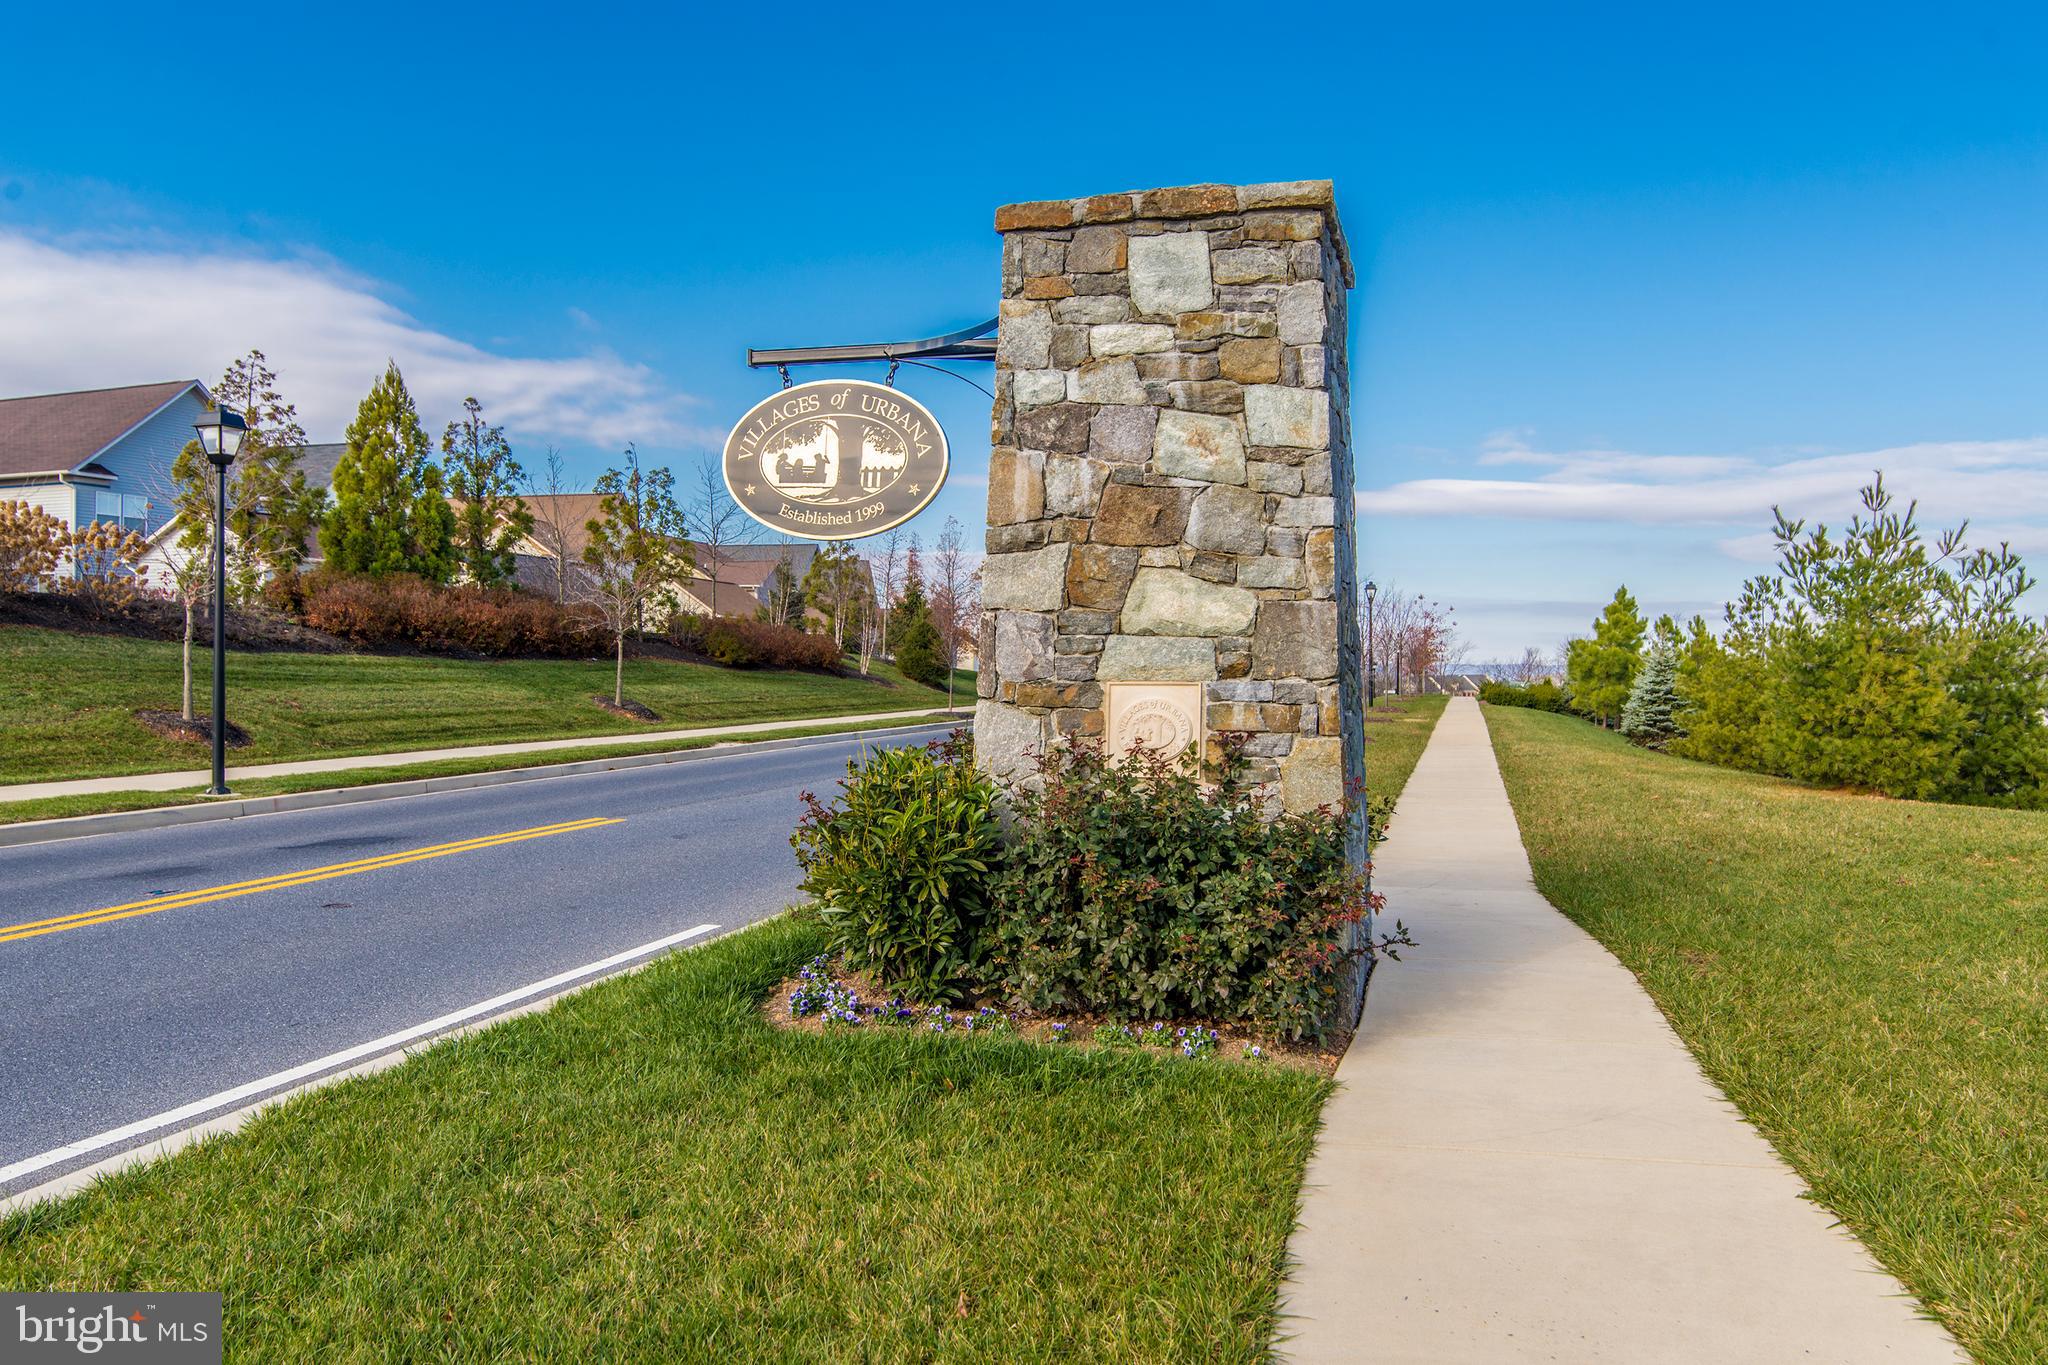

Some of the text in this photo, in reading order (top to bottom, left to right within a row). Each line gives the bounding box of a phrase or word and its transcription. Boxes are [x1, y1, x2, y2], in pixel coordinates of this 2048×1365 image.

[738, 388, 932, 461] VILLAGES of URBANA
[779, 501, 885, 525] Established 1999
